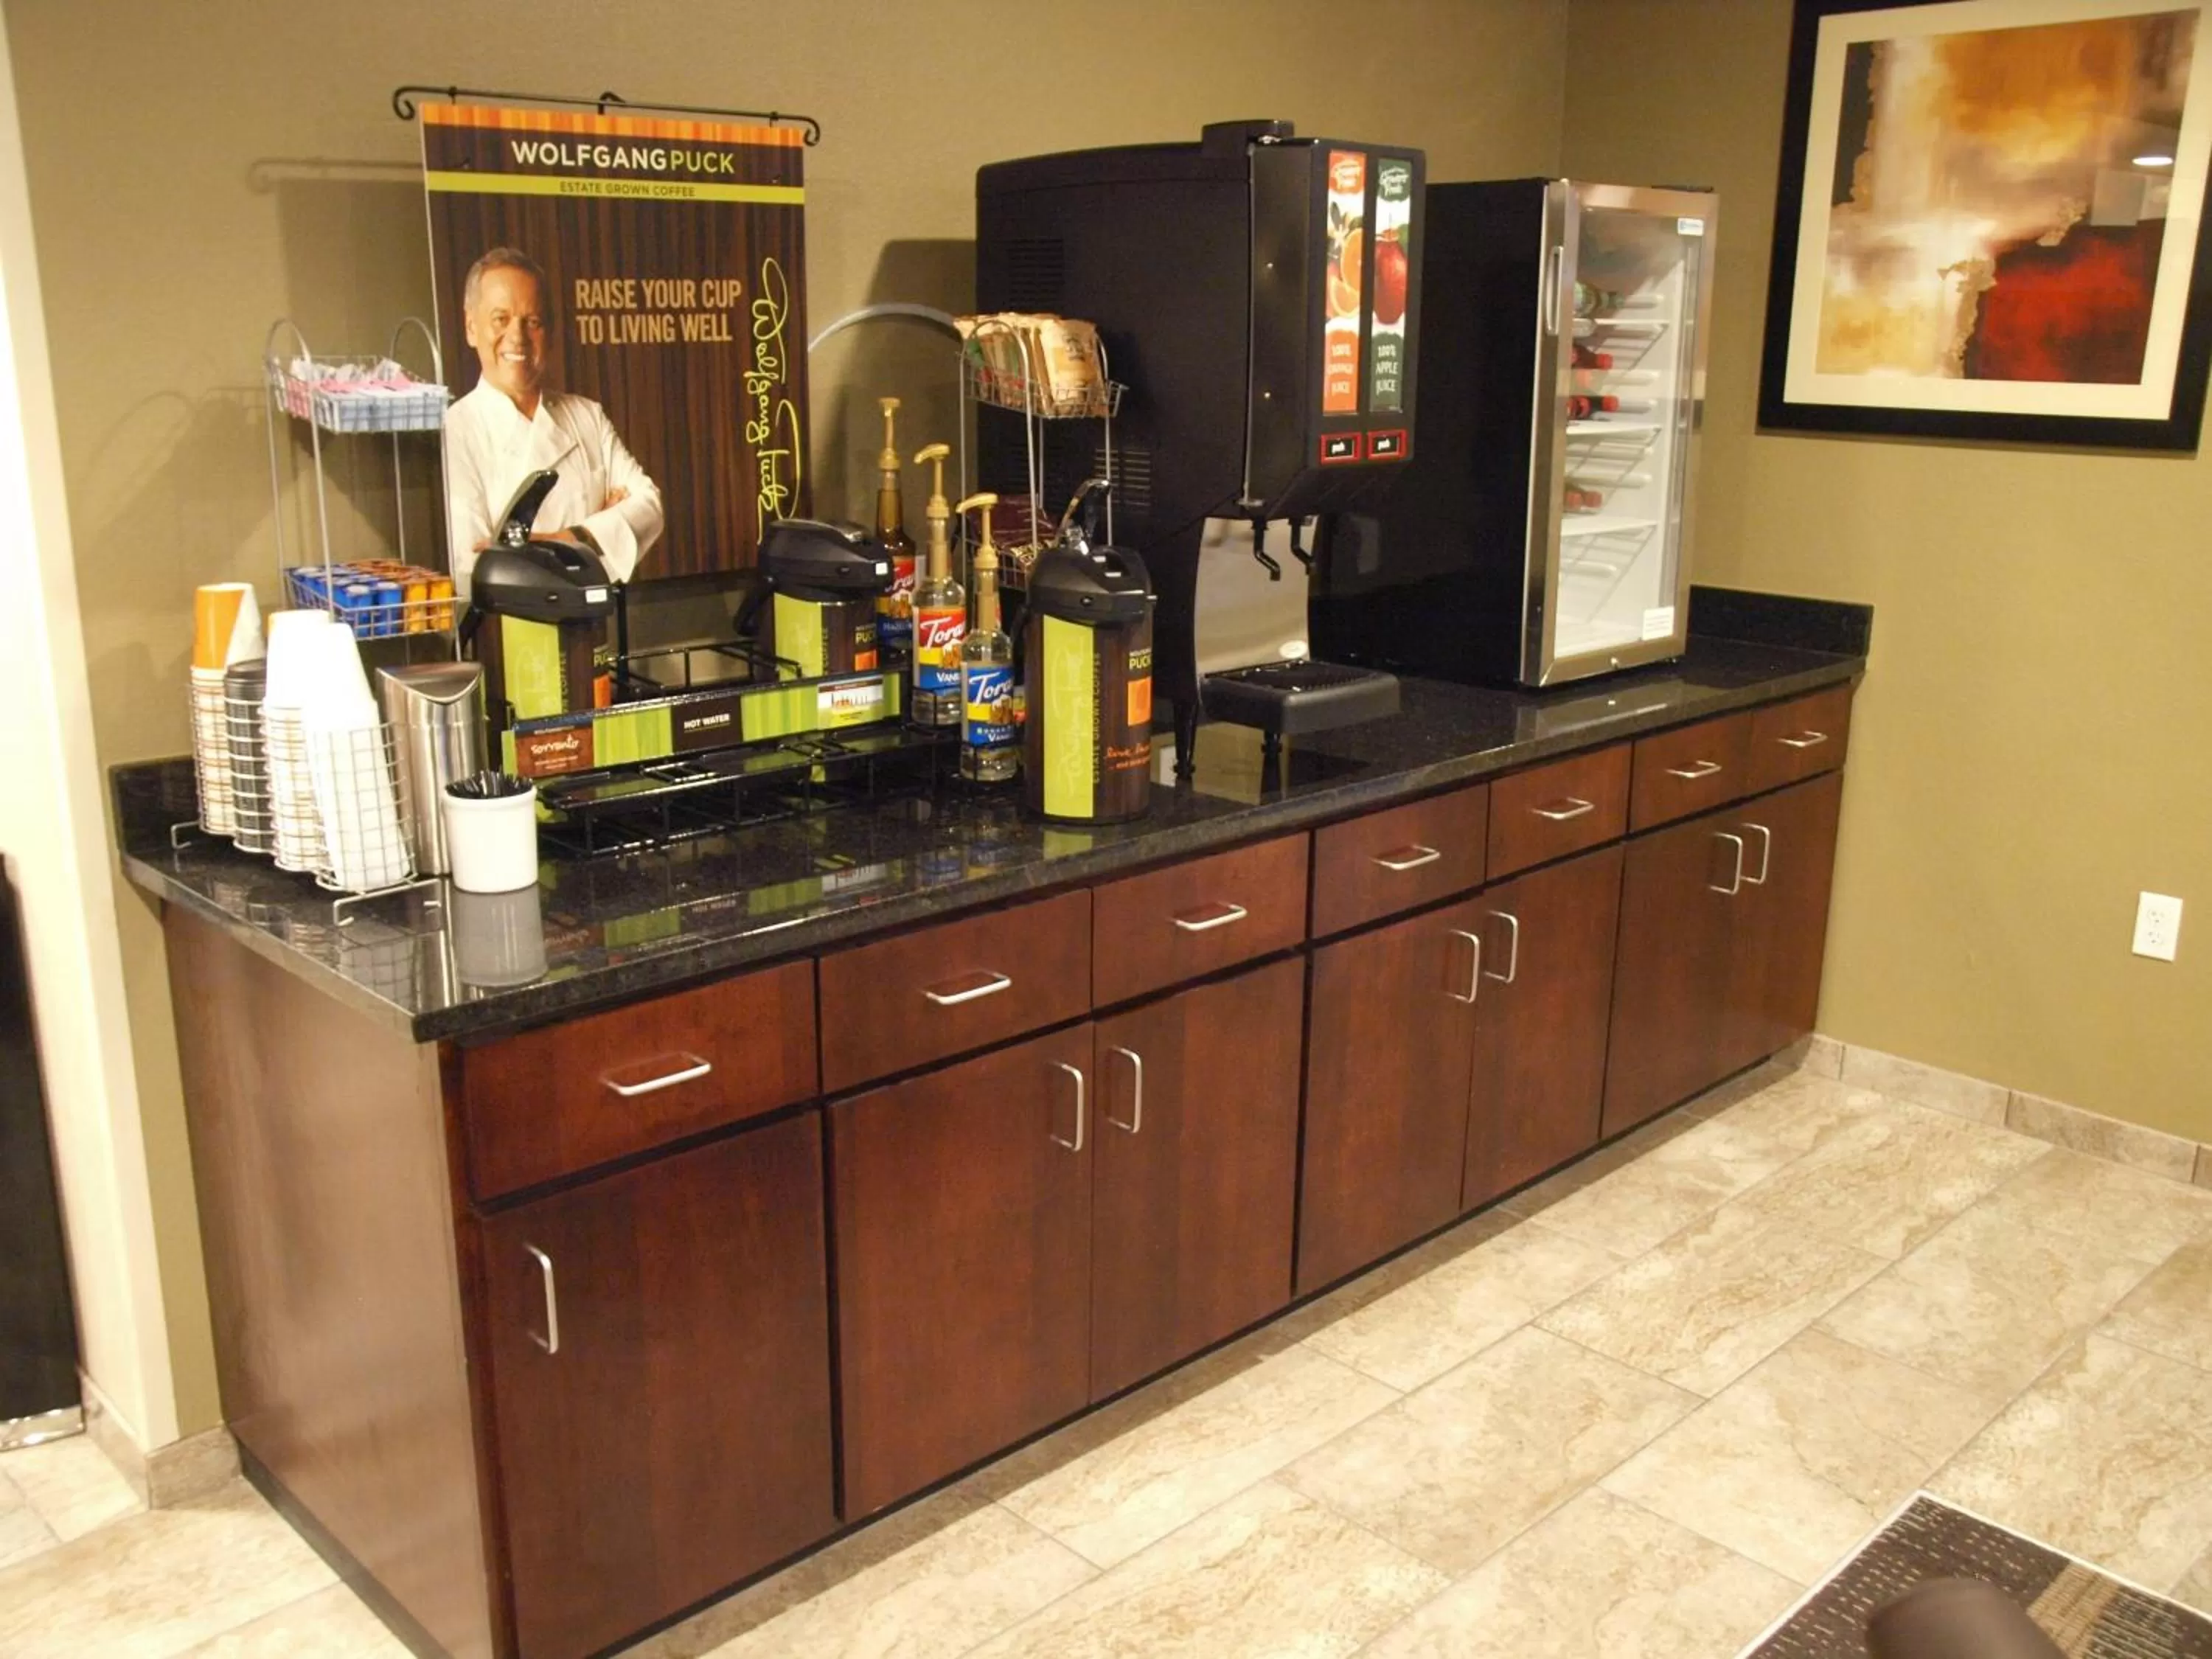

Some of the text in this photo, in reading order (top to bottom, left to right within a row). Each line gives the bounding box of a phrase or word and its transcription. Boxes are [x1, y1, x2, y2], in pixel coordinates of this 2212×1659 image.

[560, 181, 695, 197] ESTATE GROWN COFFEE
[575, 278, 742, 309] RAISE YOUR CUP
[576, 313, 733, 344] TO LIVING WELL
[920, 616, 964, 650] Tora
[968, 672, 1013, 706] Tora
[684, 713, 730, 729] HOT WATER
